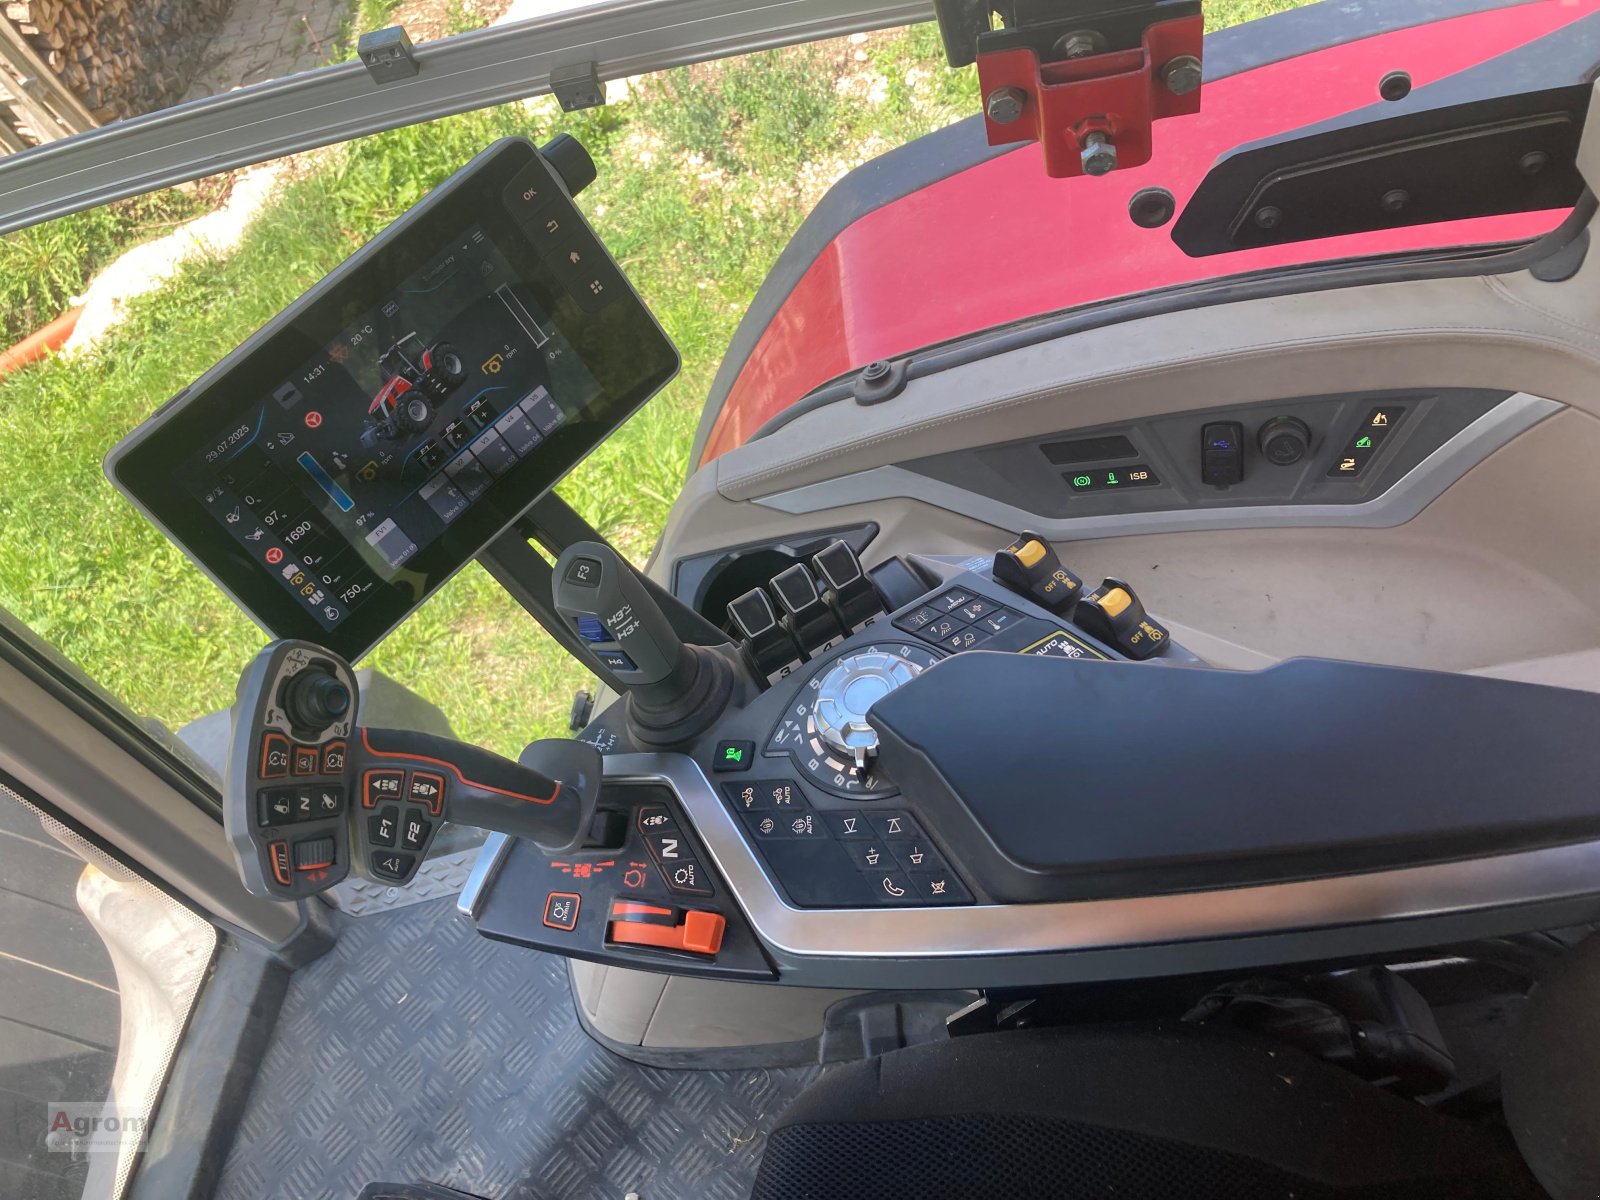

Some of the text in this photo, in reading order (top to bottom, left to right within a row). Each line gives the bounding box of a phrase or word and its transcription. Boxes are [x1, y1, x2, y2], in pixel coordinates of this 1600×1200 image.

[523, 187, 537, 200] OK
[350, 332, 363, 346] 20
[505, 348, 518, 360] rpm
[303, 363, 326, 385] 14:31
[504, 415, 514, 424] V4
[205, 424, 250, 463] 29.07.2025
[480, 436, 490, 446] V3
[1129, 471, 1148, 481] ISB
[244, 495, 255, 506] 0
[264, 510, 280, 527] 97
[355, 514, 367, 527] 97
[284, 520, 312, 546] 1690
[375, 525, 388, 538] FV1
[303, 555, 314, 565] 0
[577, 564, 590, 580] F3
[322, 574, 332, 585] 0
[340, 583, 361, 604] 750
[1044, 581, 1057, 593] OFF
[947, 596, 966, 611] MENU
[952, 636, 962, 647] 2
[1130, 632, 1144, 644] OFF
[900, 645, 912, 658] 2
[1035, 639, 1058, 656] AUTO
[608, 657, 624, 667] H4
[779, 665, 791, 680] 3
[809, 677, 821, 690] 5
[796, 703, 807, 716] 6
[793, 733, 804, 745] 7
[280, 753, 287, 766] C1
[337, 754, 344, 768] C2
[807, 758, 820, 771] 8
[833, 773, 846, 786] 9
[300, 797, 310, 811] N
[379, 818, 392, 839] F1
[407, 821, 420, 843] F2
[661, 838, 679, 858] N
